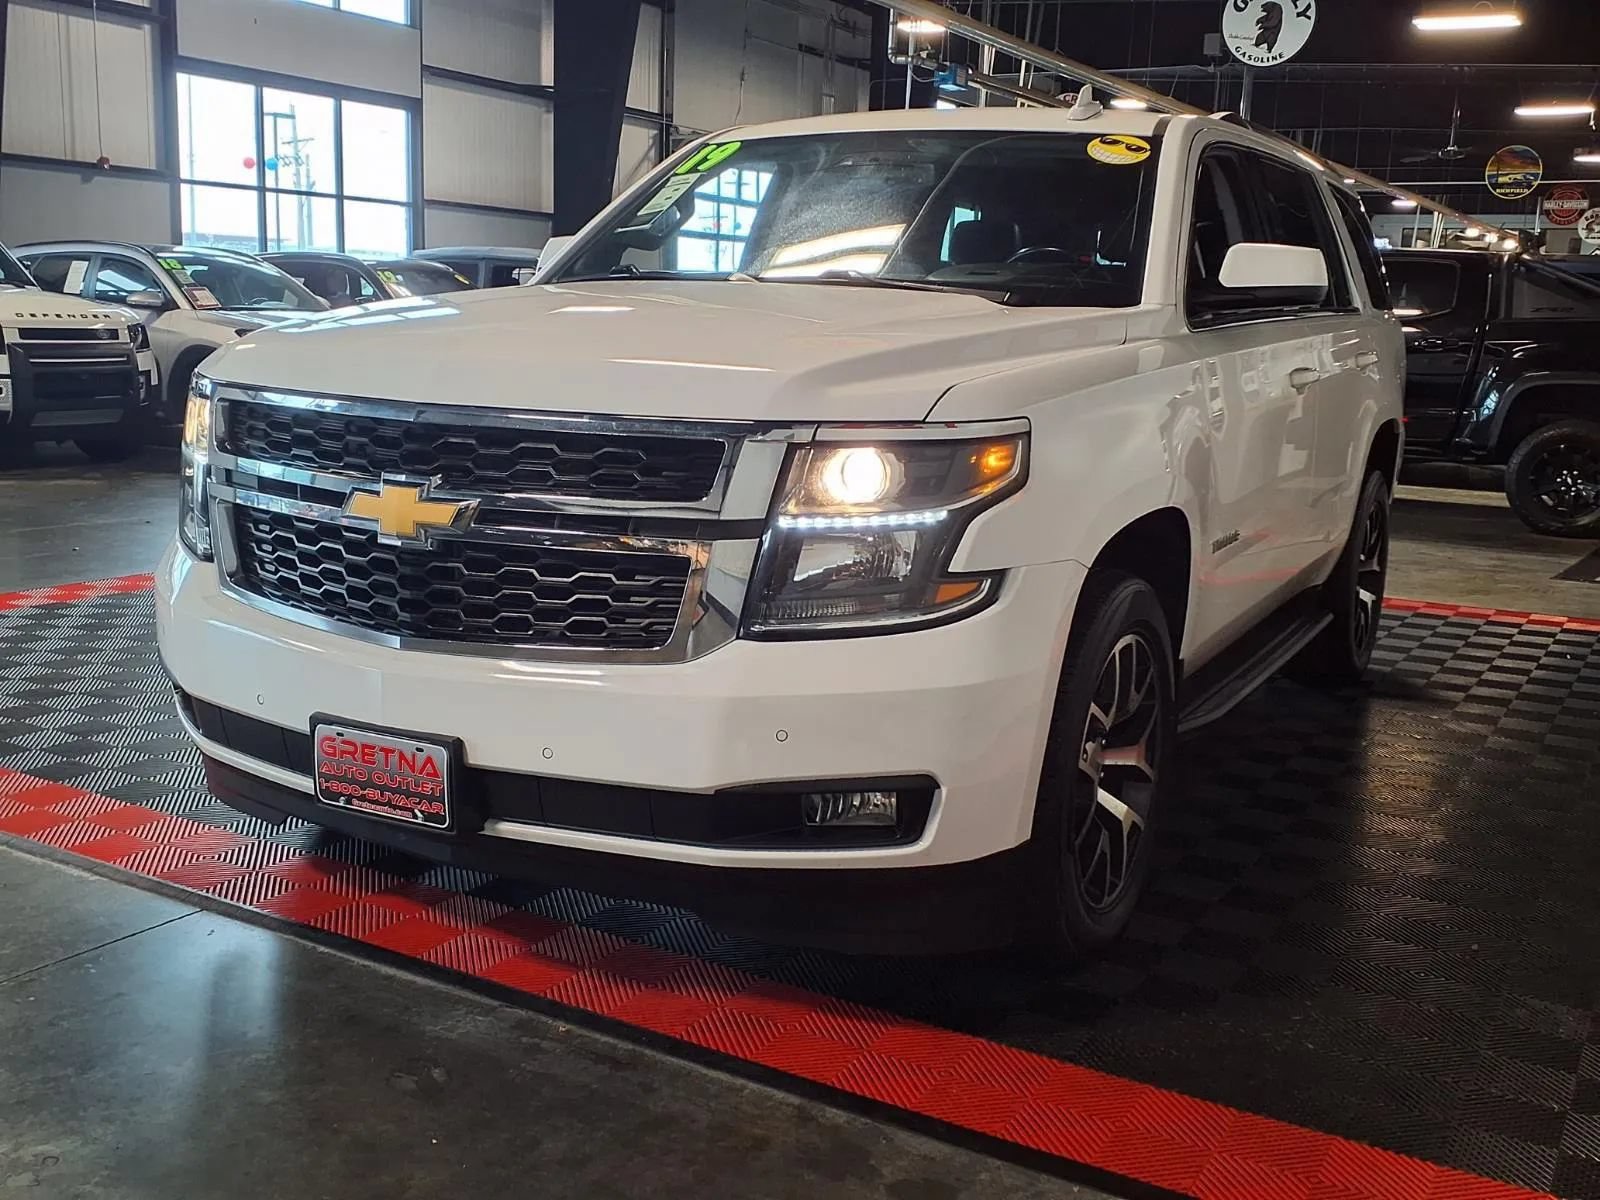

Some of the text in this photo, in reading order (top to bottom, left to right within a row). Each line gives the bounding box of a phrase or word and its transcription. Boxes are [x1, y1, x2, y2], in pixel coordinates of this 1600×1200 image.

[1235, 46, 1285, 63] GASOLINE
[675, 141, 742, 175] 19
[319, 735, 442, 780] GRETNA
[319, 778, 444, 815] 1-800-BUYACAR
[320, 760, 444, 797] AUTO OUTLET
